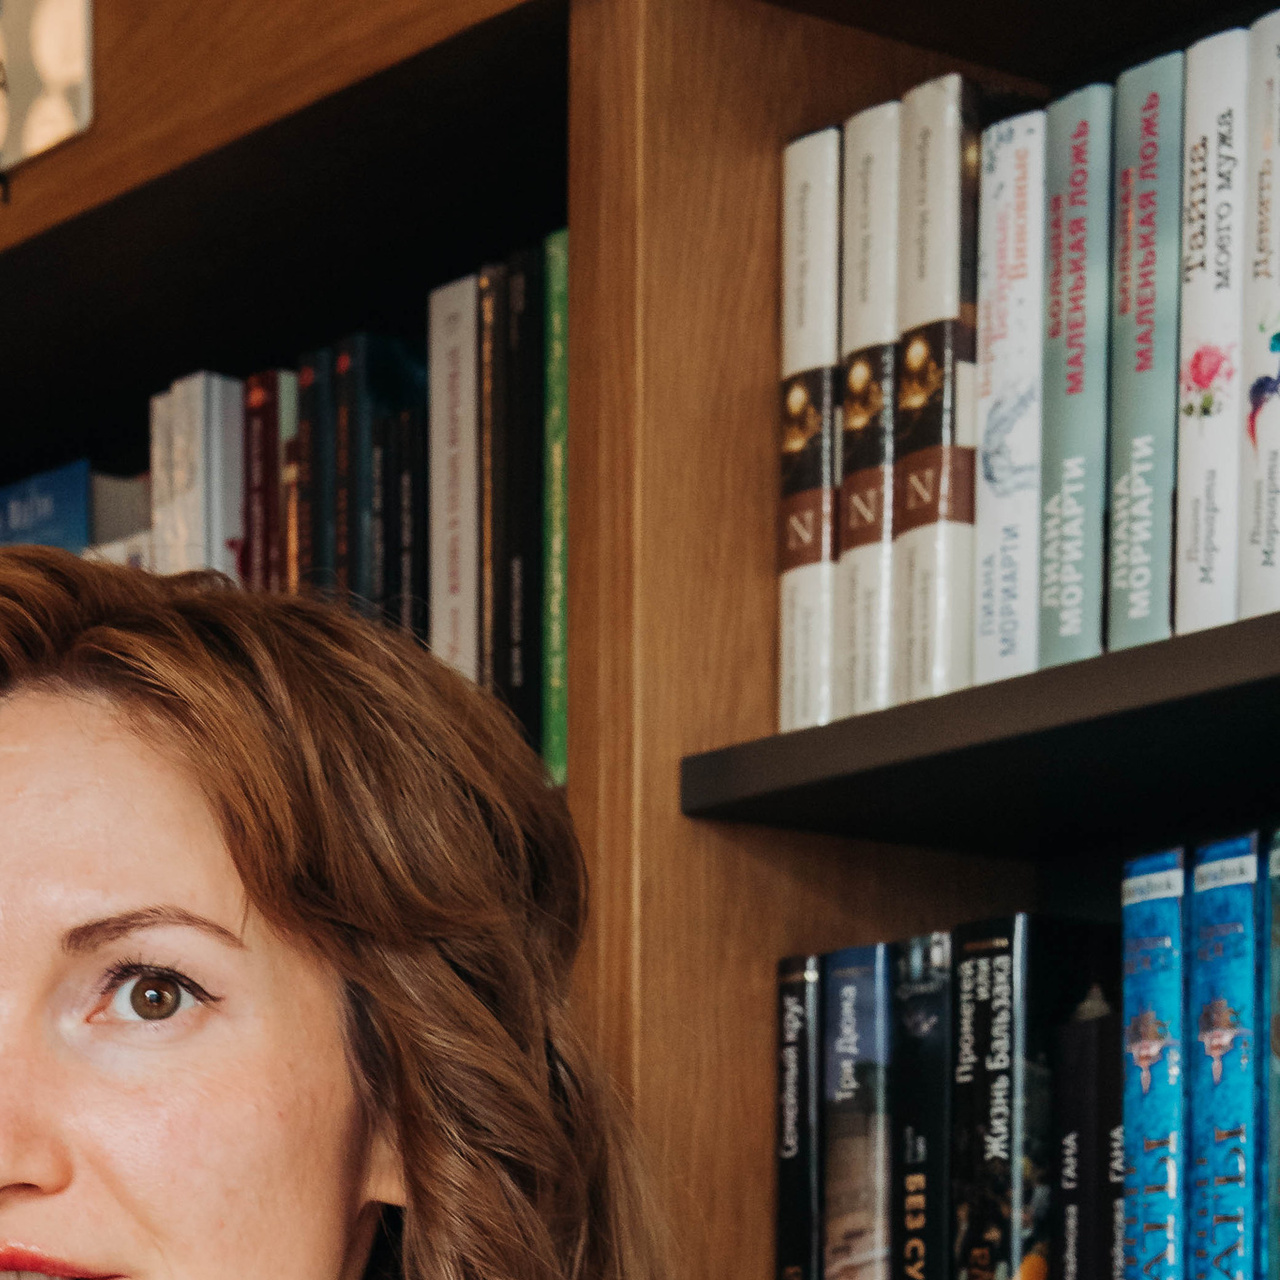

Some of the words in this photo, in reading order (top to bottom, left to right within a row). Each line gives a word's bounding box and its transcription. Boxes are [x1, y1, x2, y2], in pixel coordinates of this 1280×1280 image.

[1069, 119, 1090, 207] ЛОЖЬ
[1138, 91, 1161, 181] ЛОЖЬ
[1217, 107, 1238, 192] мужа
[1182, 135, 1209, 286] Тайна
[1214, 202, 1233, 291] моего
[1066, 216, 1087, 395] МАЛЕНЬКАЯ
[1135, 189, 1159, 373] МАЛЕНЬКАЯ
[1058, 455, 1085, 637] МОРИАРТИ
[1128, 433, 1156, 620] МОРИАРТИ
[998, 524, 1020, 658] МОРИАРТИ
[782, 995, 805, 1043] круг
[834, 984, 860, 1055] Дюма
[955, 959, 978, 1083] Прометей
[984, 954, 1011, 1072] Бальзака
[779, 1046, 799, 1159] Семейный
[835, 1058, 860, 1101] Три
[983, 1074, 1010, 1161] Жизнь
[1061, 1131, 1078, 1190] ГАНА
[1109, 1125, 1125, 1184] ГАНА
[904, 1173, 927, 1231] БЕЗ
